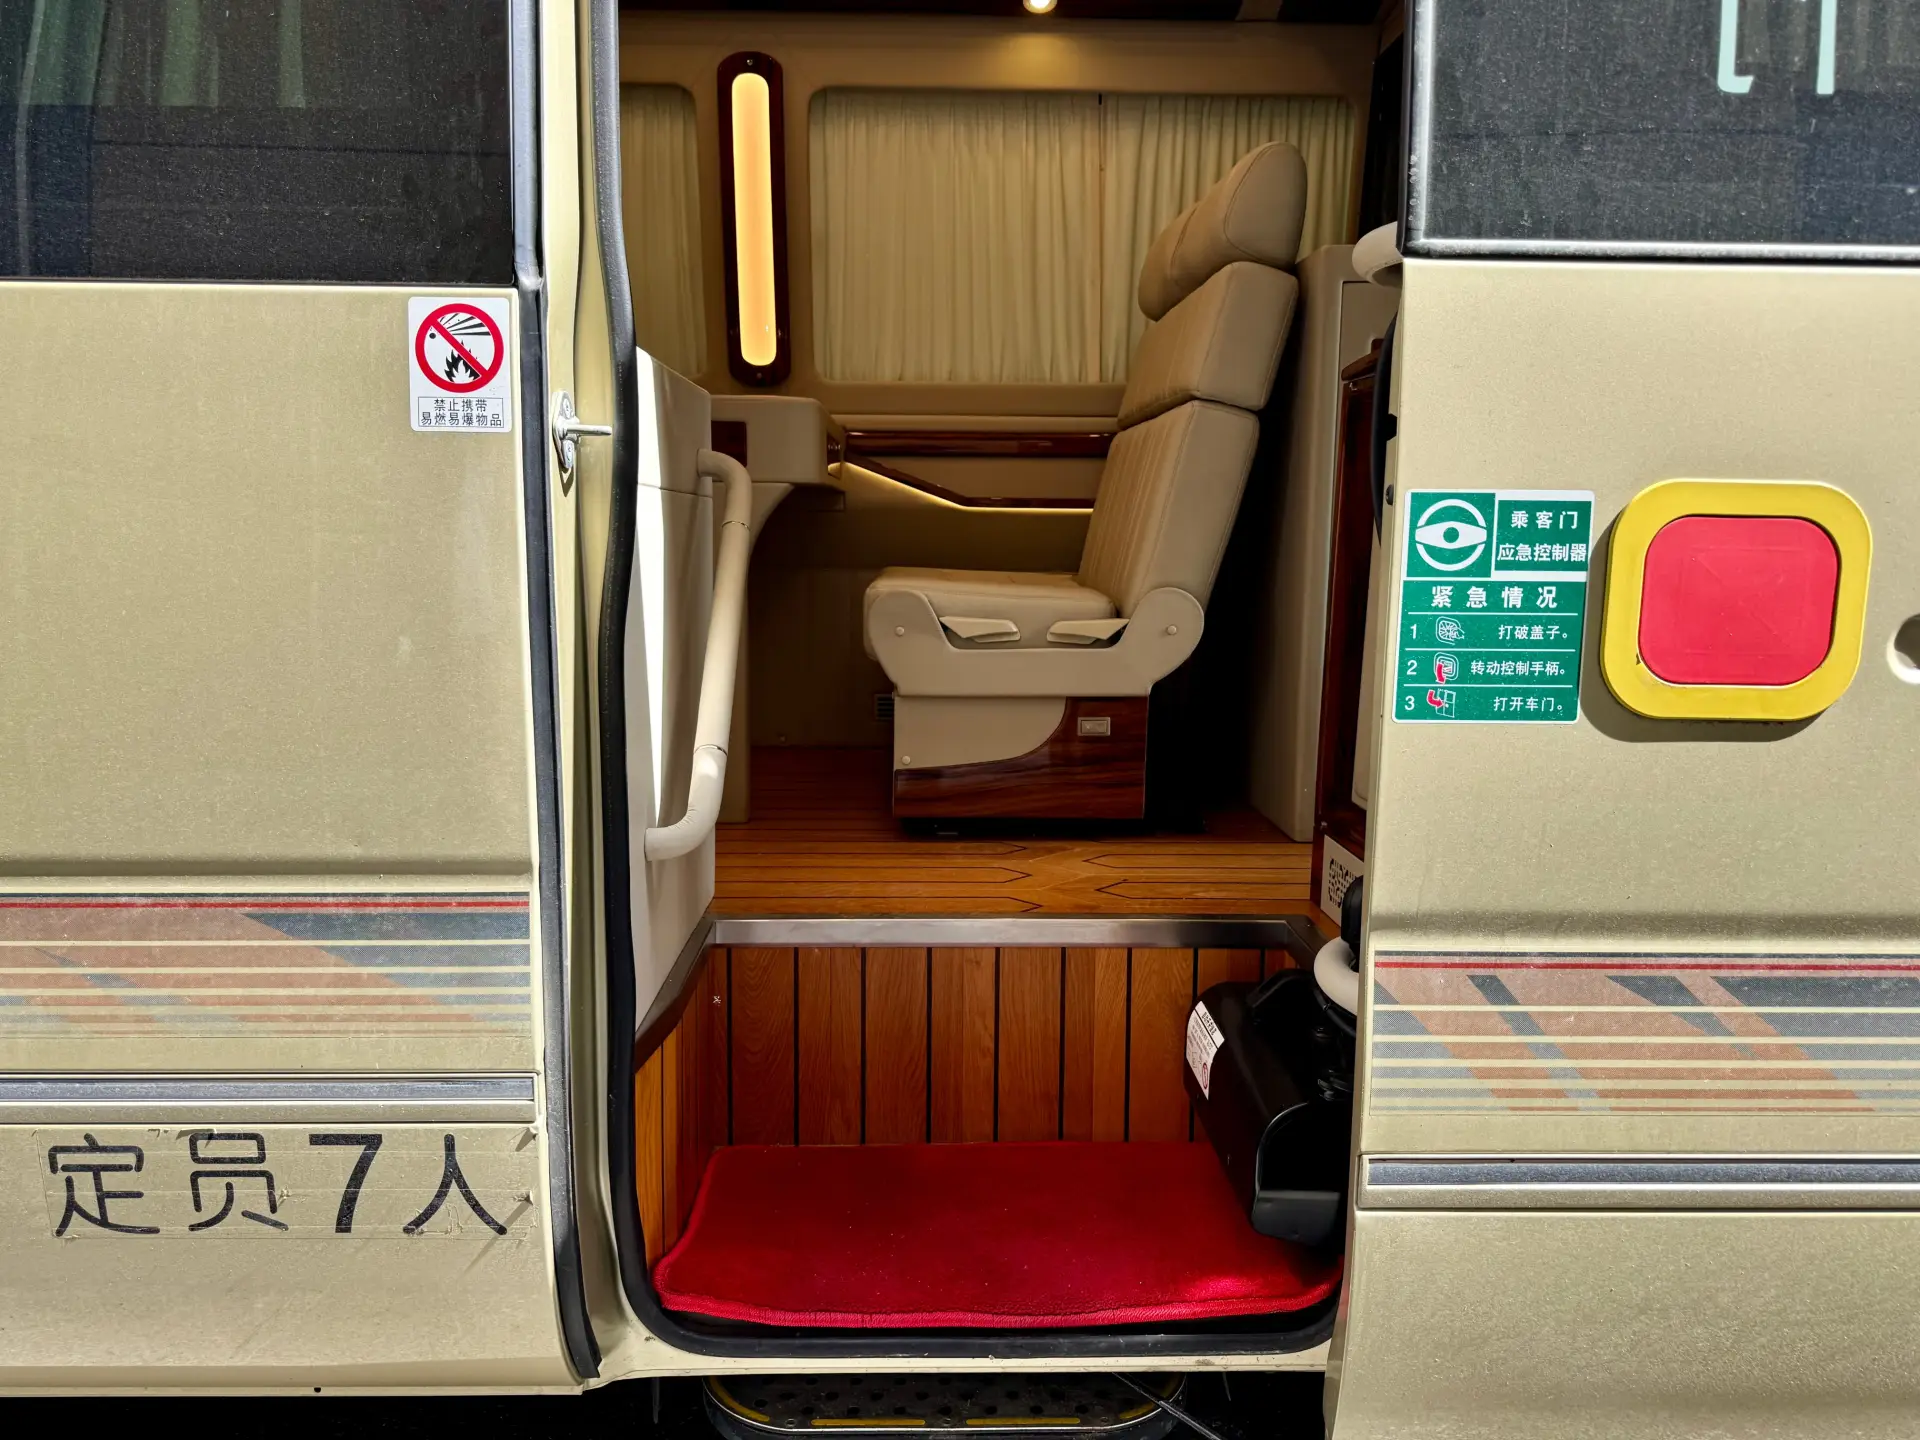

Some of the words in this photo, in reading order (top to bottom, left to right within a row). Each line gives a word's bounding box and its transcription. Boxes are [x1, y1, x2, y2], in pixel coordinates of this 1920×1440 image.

[434, 398, 487, 412] 禁止携带
[421, 412, 502, 427] 易燃易爆物品
[1511, 510, 1578, 529] 乘客门
[1497, 543, 1587, 562] 应急控制器
[1431, 585, 1557, 609] 紧急情况
[1410, 624, 1418, 639] 1
[1498, 625, 1568, 640] 打破盖子。
[1407, 660, 1418, 675] 2
[1470, 660, 1566, 676] 转动控制手柄。
[1404, 696, 1415, 711] 3
[1493, 696, 1563, 711] 打开车门。
[48, 1132, 508, 1237] 定员7人
